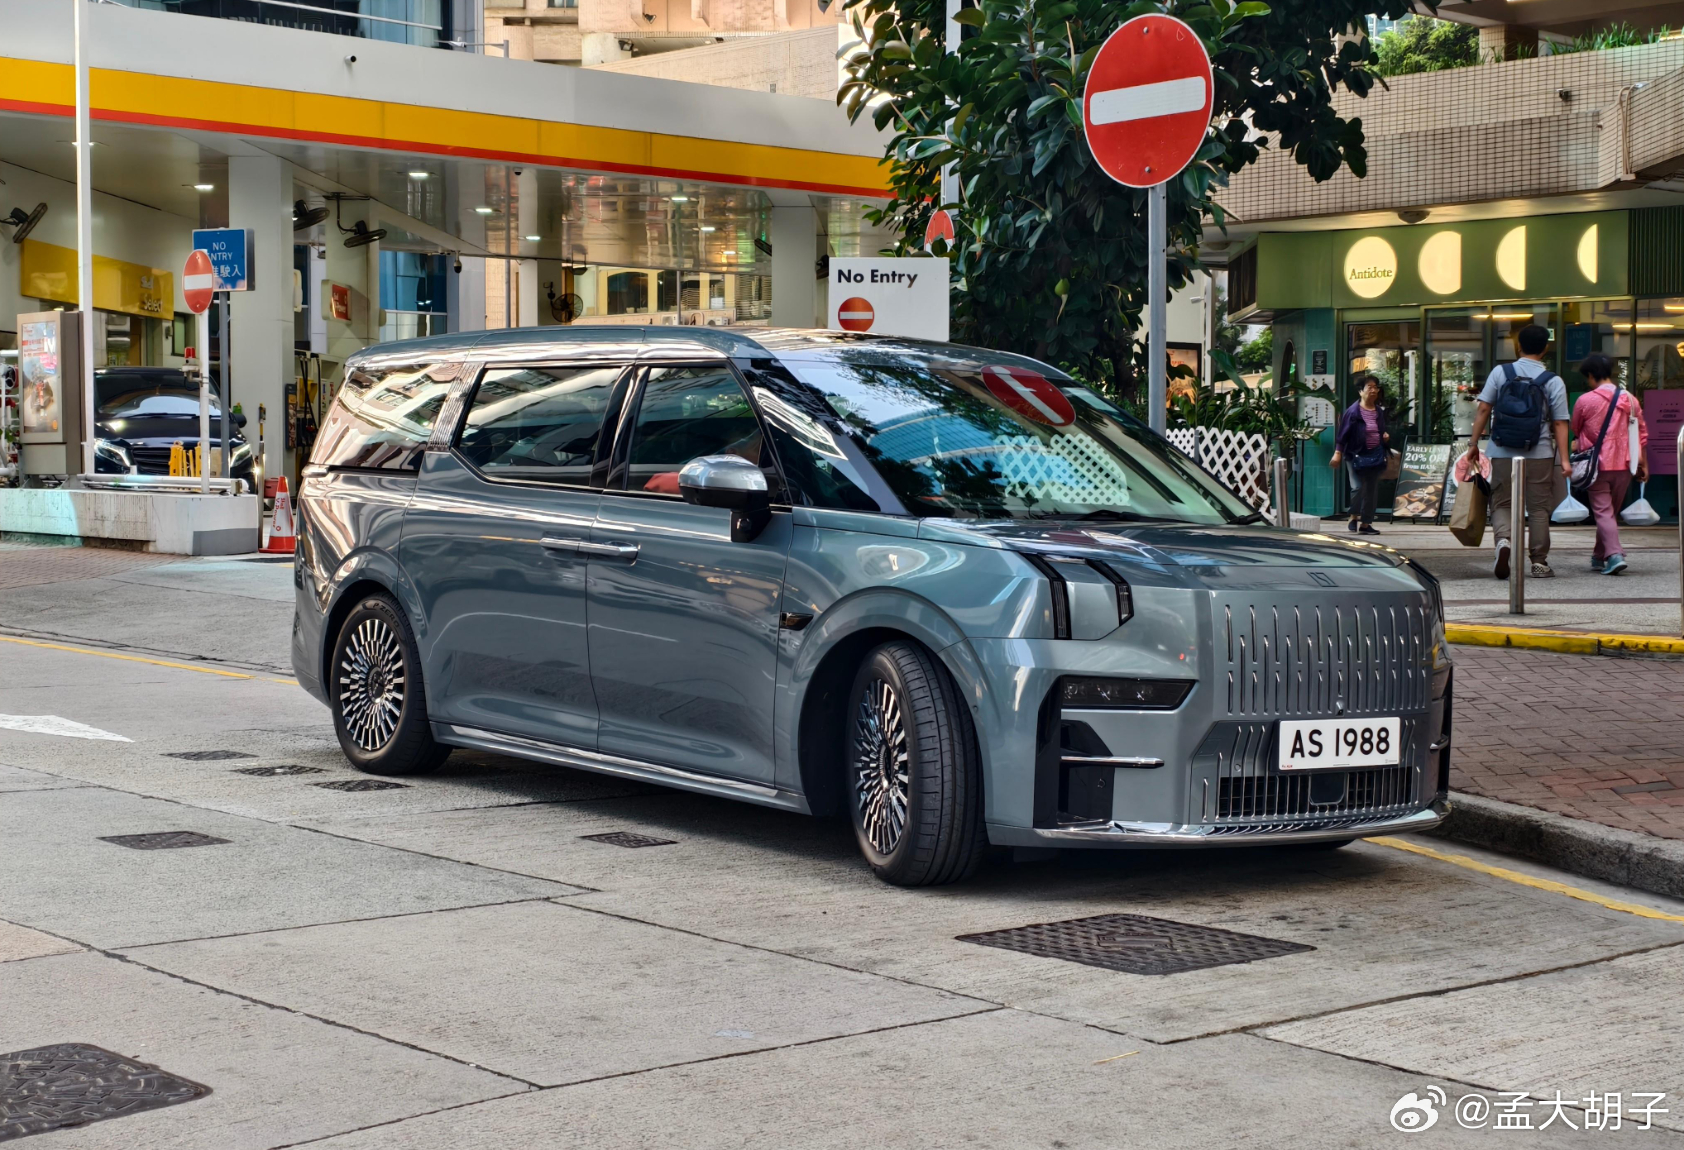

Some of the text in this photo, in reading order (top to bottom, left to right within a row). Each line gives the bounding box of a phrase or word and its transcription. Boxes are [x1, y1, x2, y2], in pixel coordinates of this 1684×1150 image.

[212, 241, 226, 251] NO
[837, 269, 918, 288] No Entry
[1349, 266, 1393, 280] Antidote
[1405, 453, 1427, 462] 20%
[380, 604, 400, 628] ZERO
[1290, 727, 1390, 758] AS 1988
